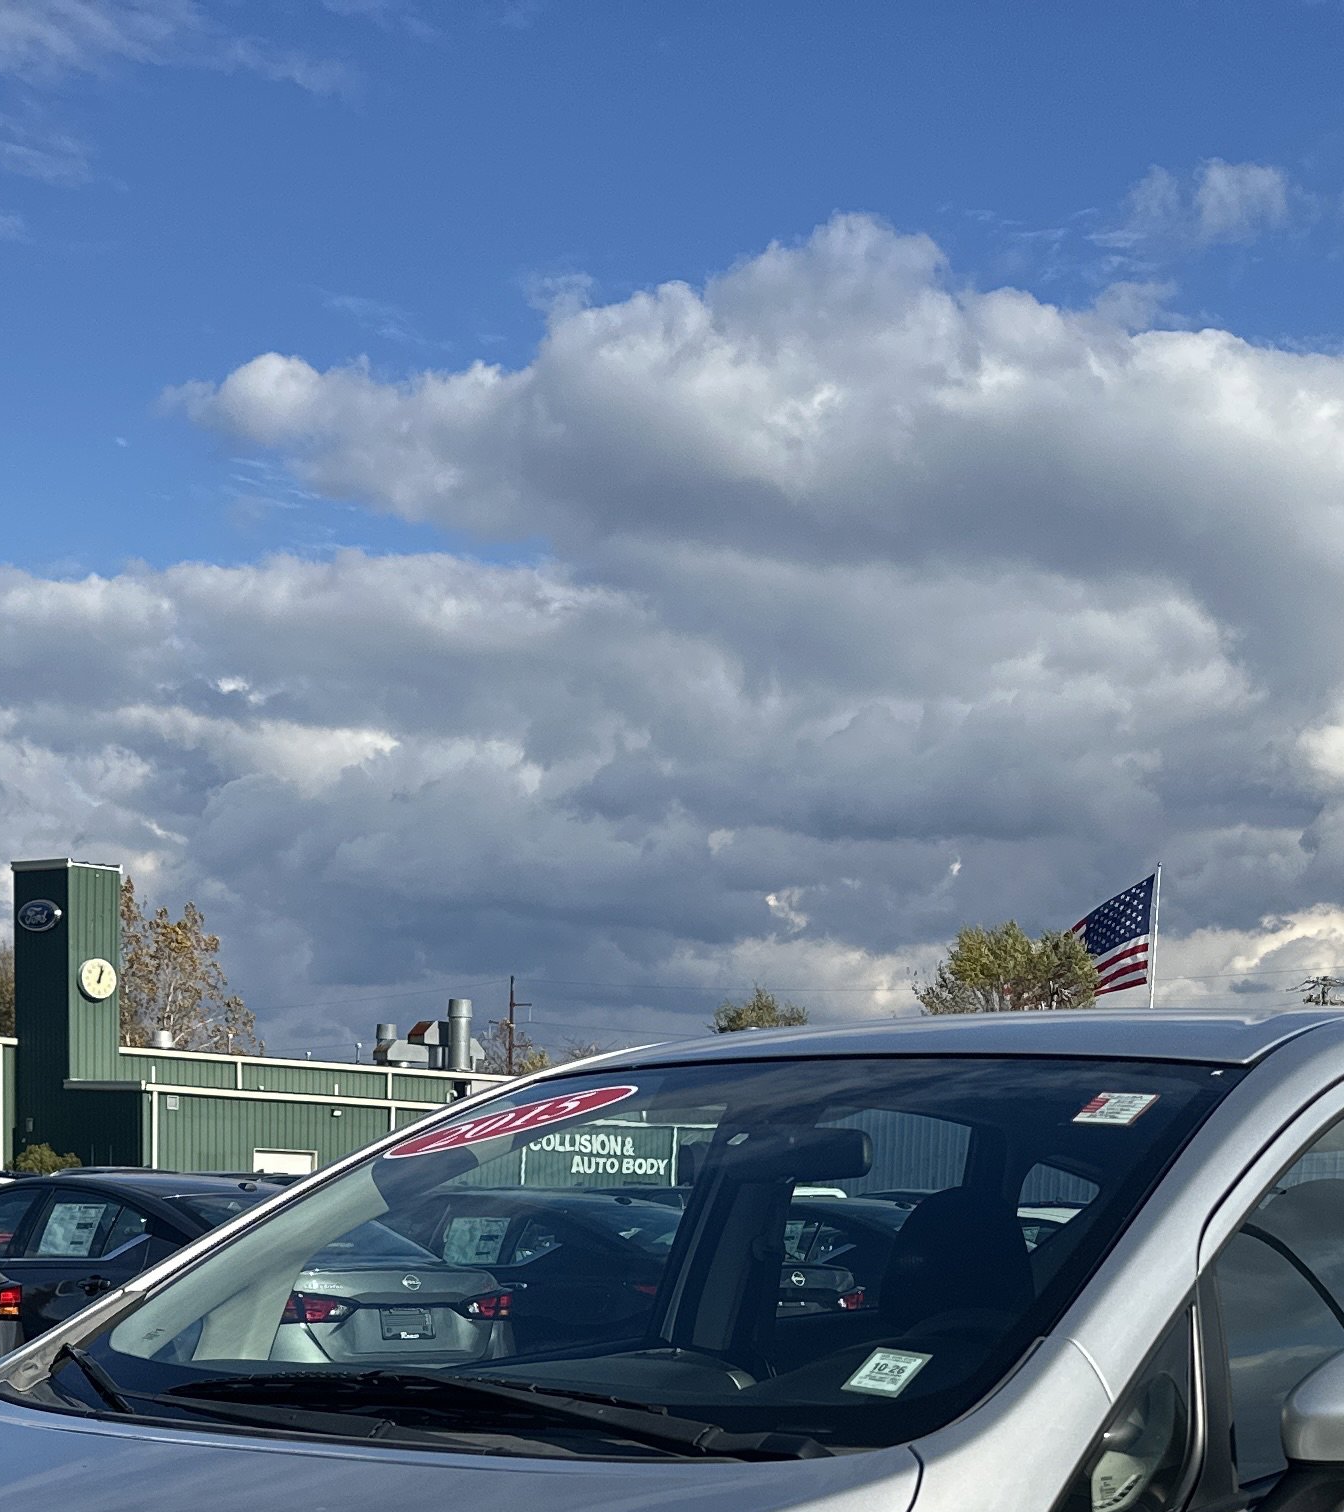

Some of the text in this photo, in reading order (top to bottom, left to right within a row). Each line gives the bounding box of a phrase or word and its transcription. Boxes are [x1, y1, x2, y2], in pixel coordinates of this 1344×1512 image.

[417, 1091, 597, 1152] 2015
[529, 1133, 635, 1156] COLLISION &
[571, 1155, 669, 1175] AUTO BODY
